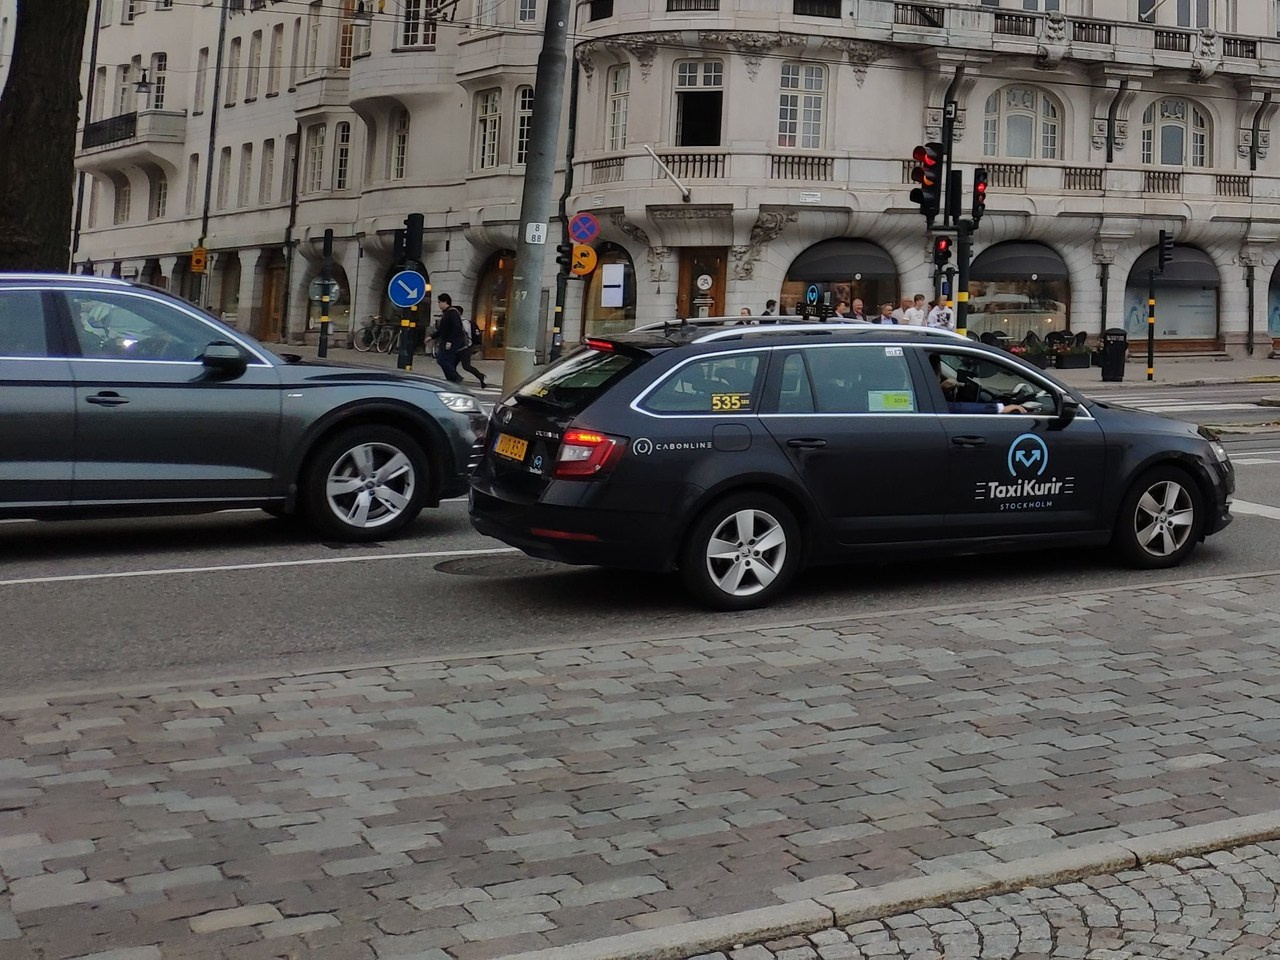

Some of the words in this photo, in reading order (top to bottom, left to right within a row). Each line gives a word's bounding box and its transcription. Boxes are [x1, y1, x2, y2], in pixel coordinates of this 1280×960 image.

[535, 224, 541, 232] 8
[531, 234, 542, 242] 88
[712, 396, 741, 409] 535
[656, 441, 713, 451] CABONLINE
[1000, 501, 1053, 511] STOCKHOLM
